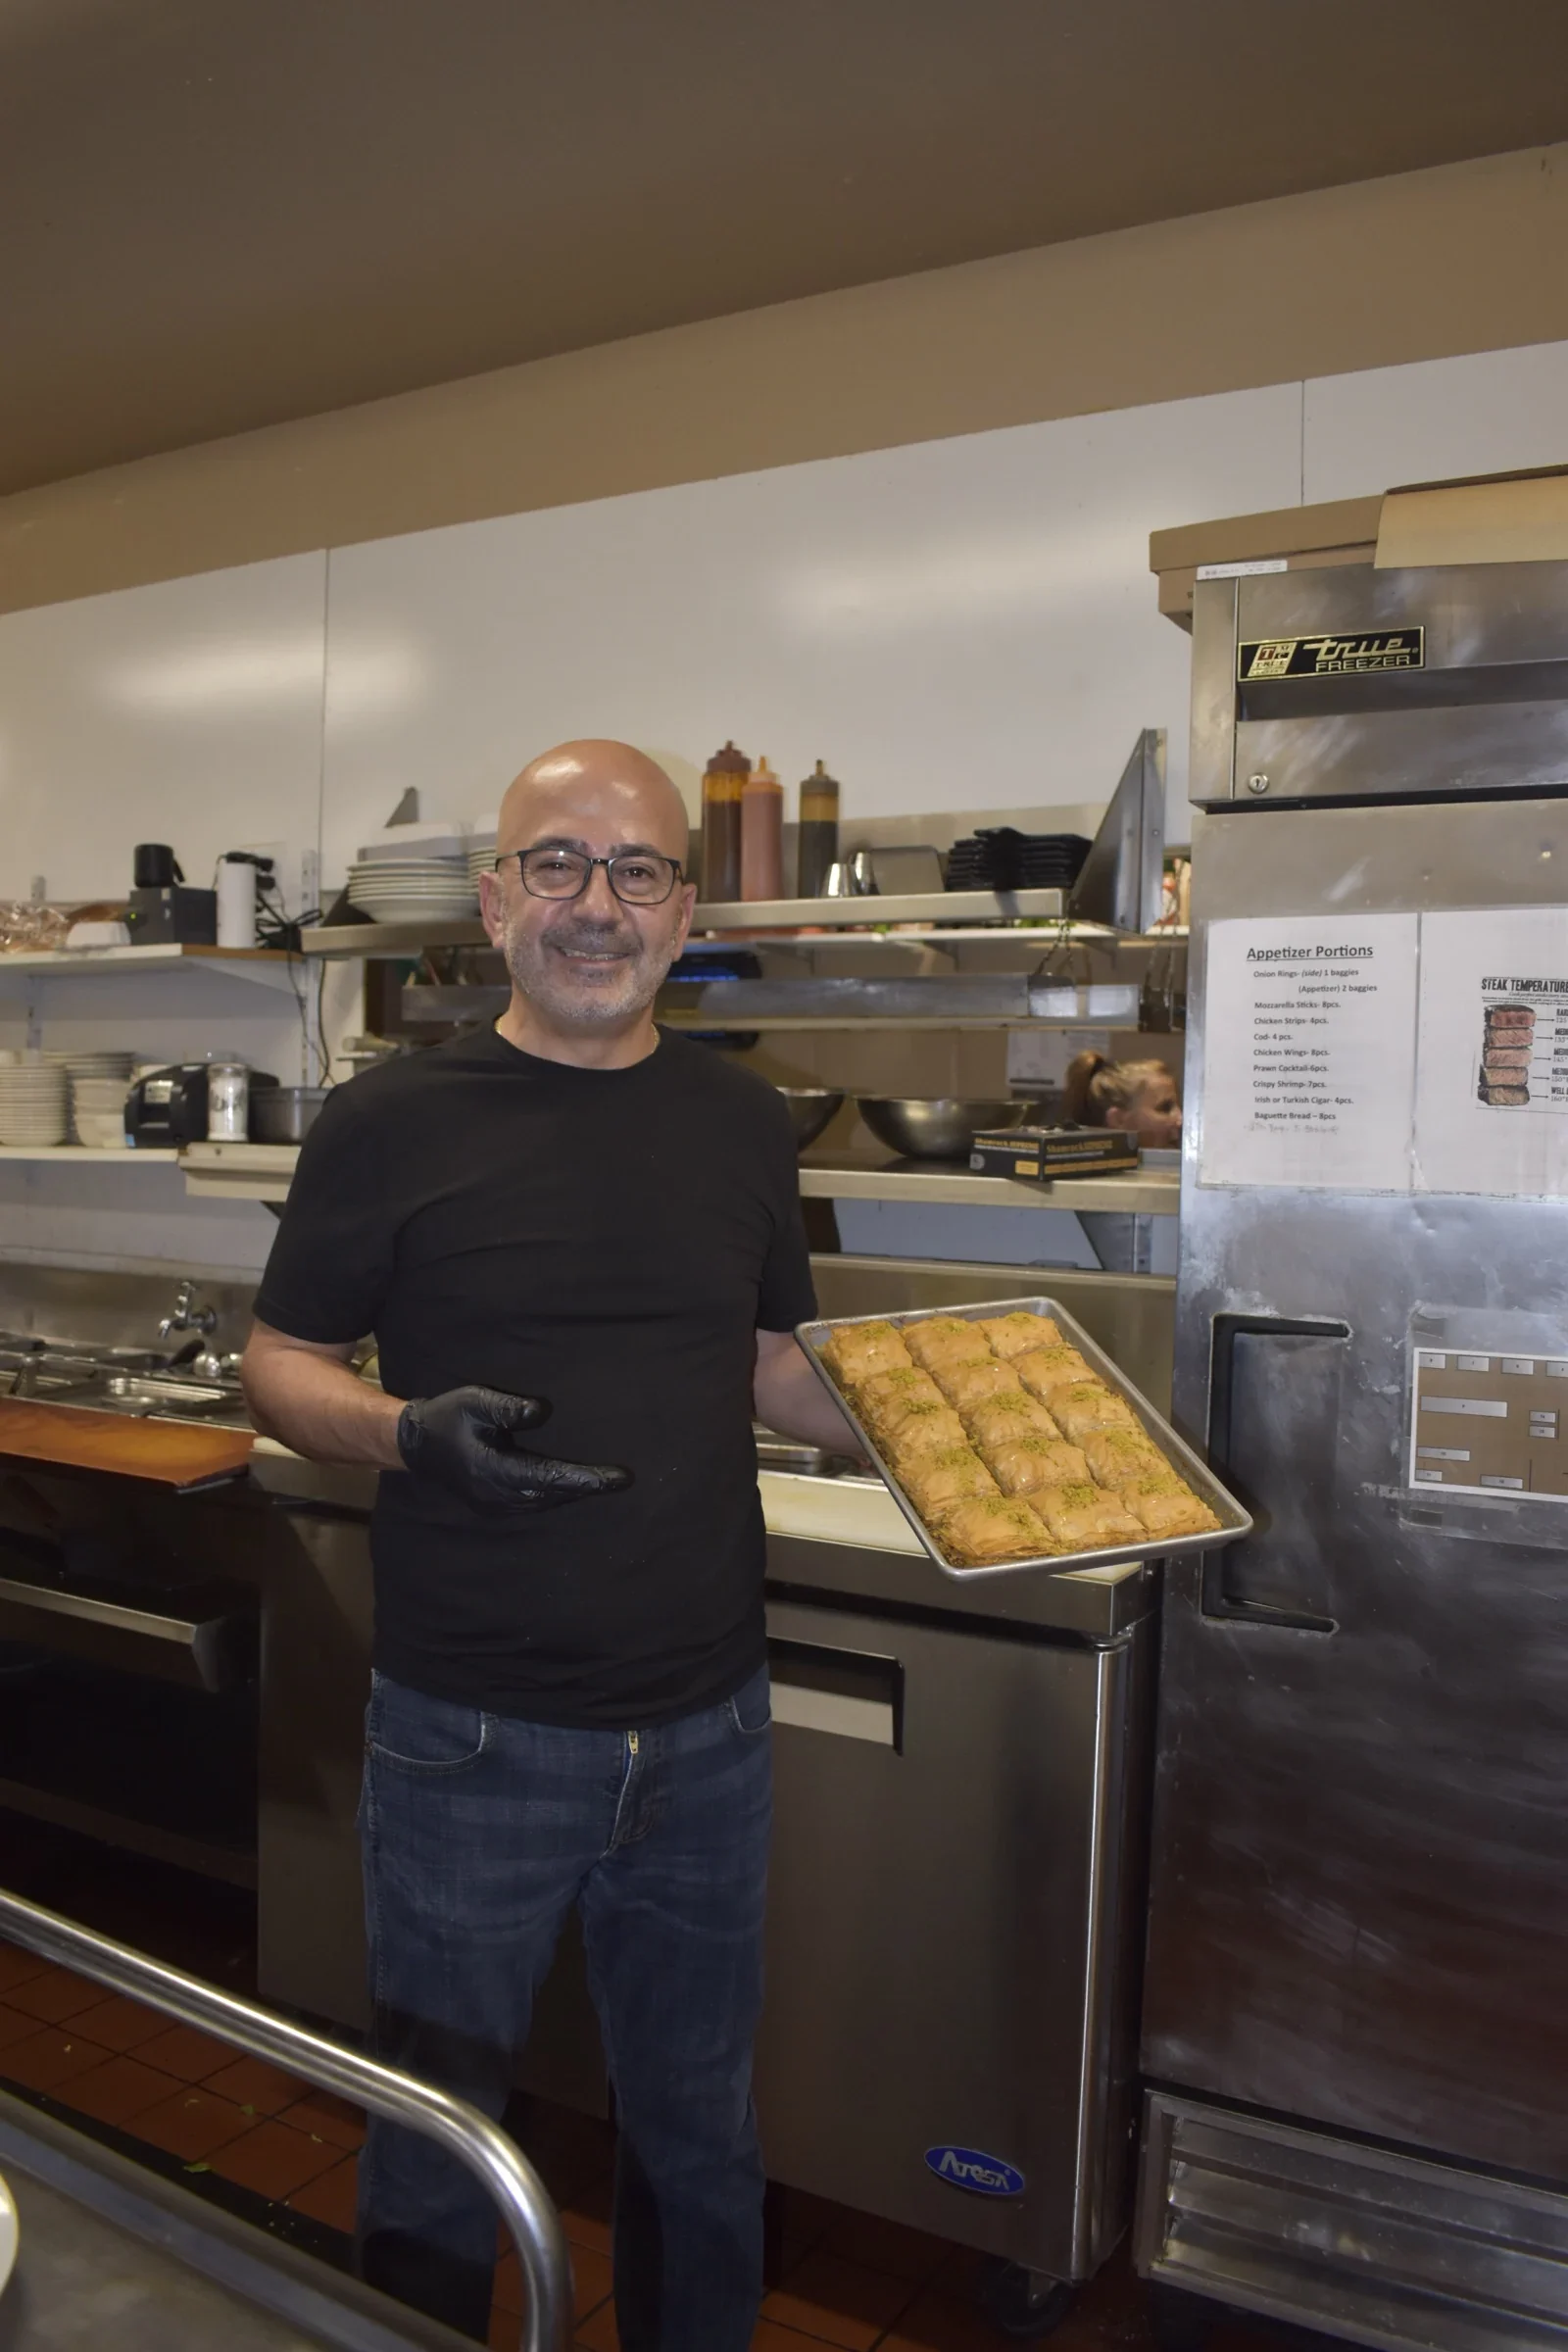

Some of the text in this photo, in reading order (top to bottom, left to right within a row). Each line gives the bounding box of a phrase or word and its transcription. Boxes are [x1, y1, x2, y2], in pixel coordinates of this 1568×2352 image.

[1315, 655, 1410, 672] FREEZER
[1246, 945, 1374, 961] Appetizer Portions
[1277, 969, 1299, 979] Rings-
[1301, 969, 1323, 979] (side)
[1330, 968, 1359, 978] baggies
[1298, 984, 1341, 994] (Appetizer)
[1348, 984, 1378, 994] baggies
[1481, 978, 1507, 991] STEAK
[1254, 1001, 1295, 1009] Mozzarella
[1322, 1001, 1342, 1009] 8pcs.
[1284, 1049, 1309, 1057] Wings-
[1252, 1080, 1328, 1089] Crispy Shrimp- 7pcs.
[1311, 1097, 1333, 1105] Cigar-
[1334, 1097, 1354, 1105] 4pcs.
